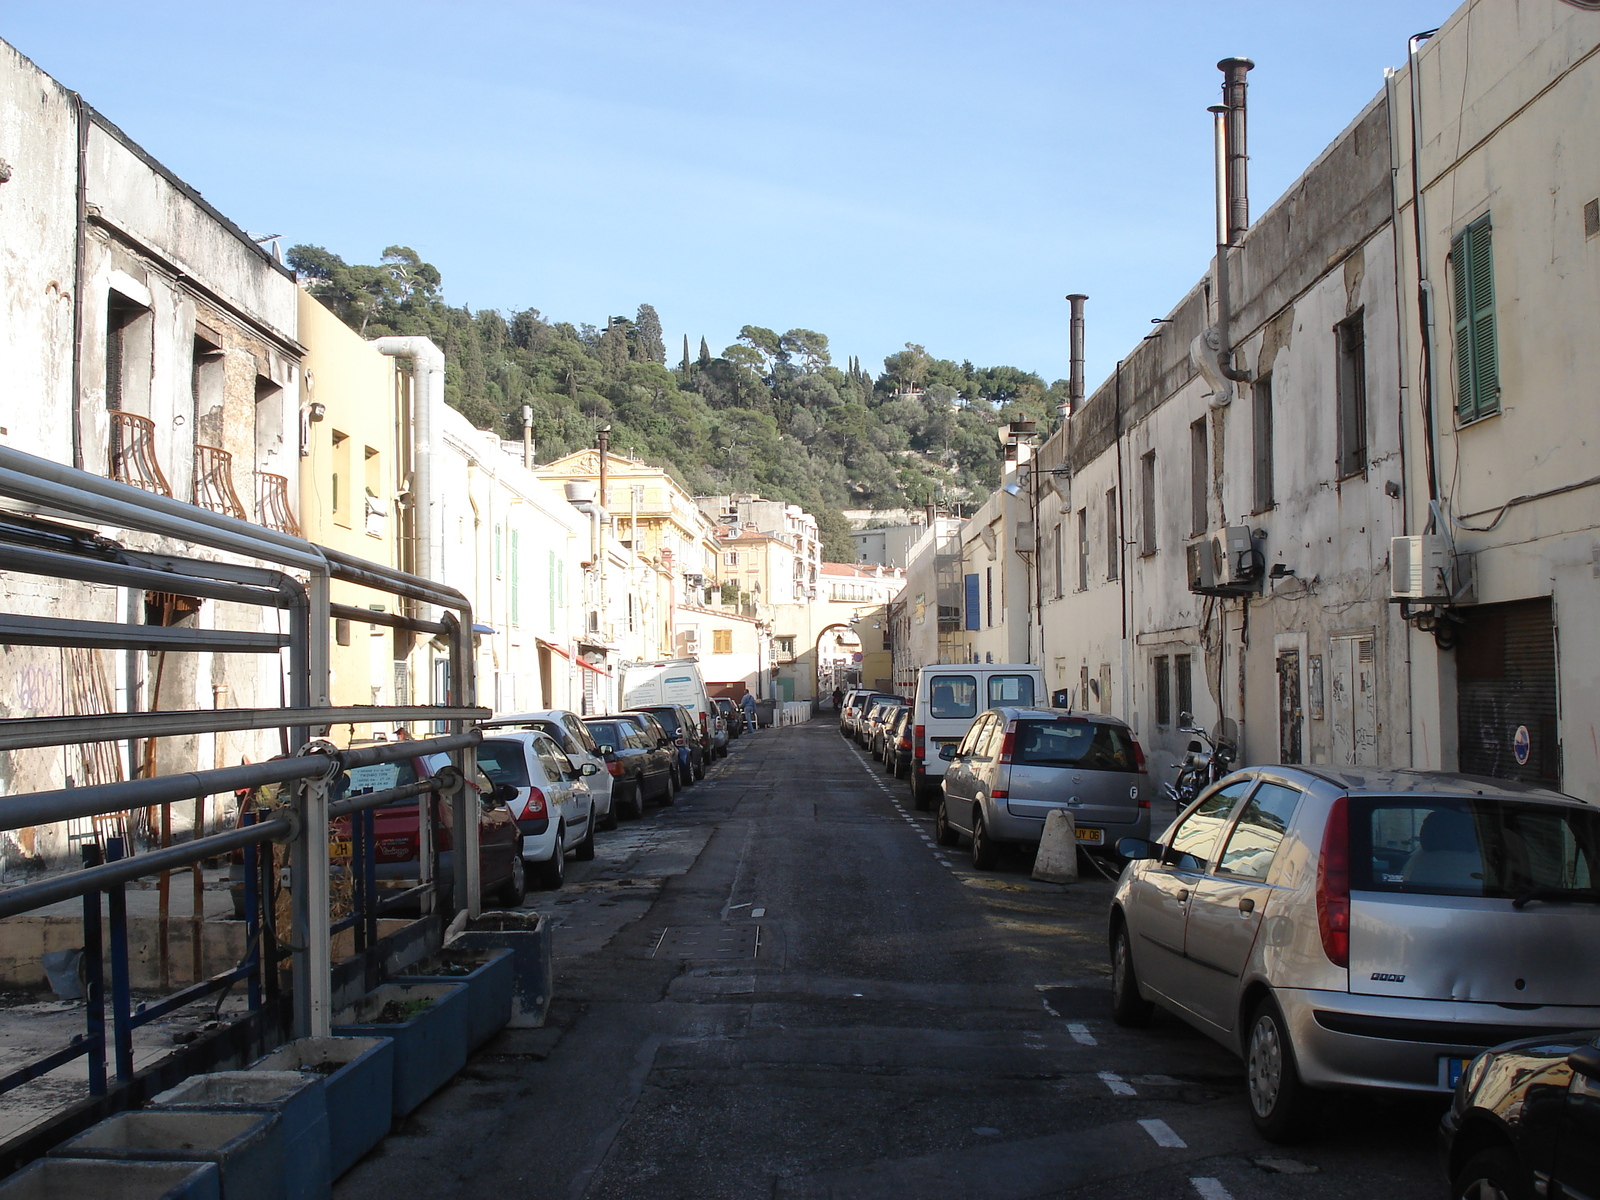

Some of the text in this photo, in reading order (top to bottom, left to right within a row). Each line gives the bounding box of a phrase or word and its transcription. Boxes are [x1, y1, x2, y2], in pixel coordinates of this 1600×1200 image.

[1059, 694, 1065, 703] P
[1089, 830, 1100, 840] 06
[1371, 973, 1405, 982] FIAT
